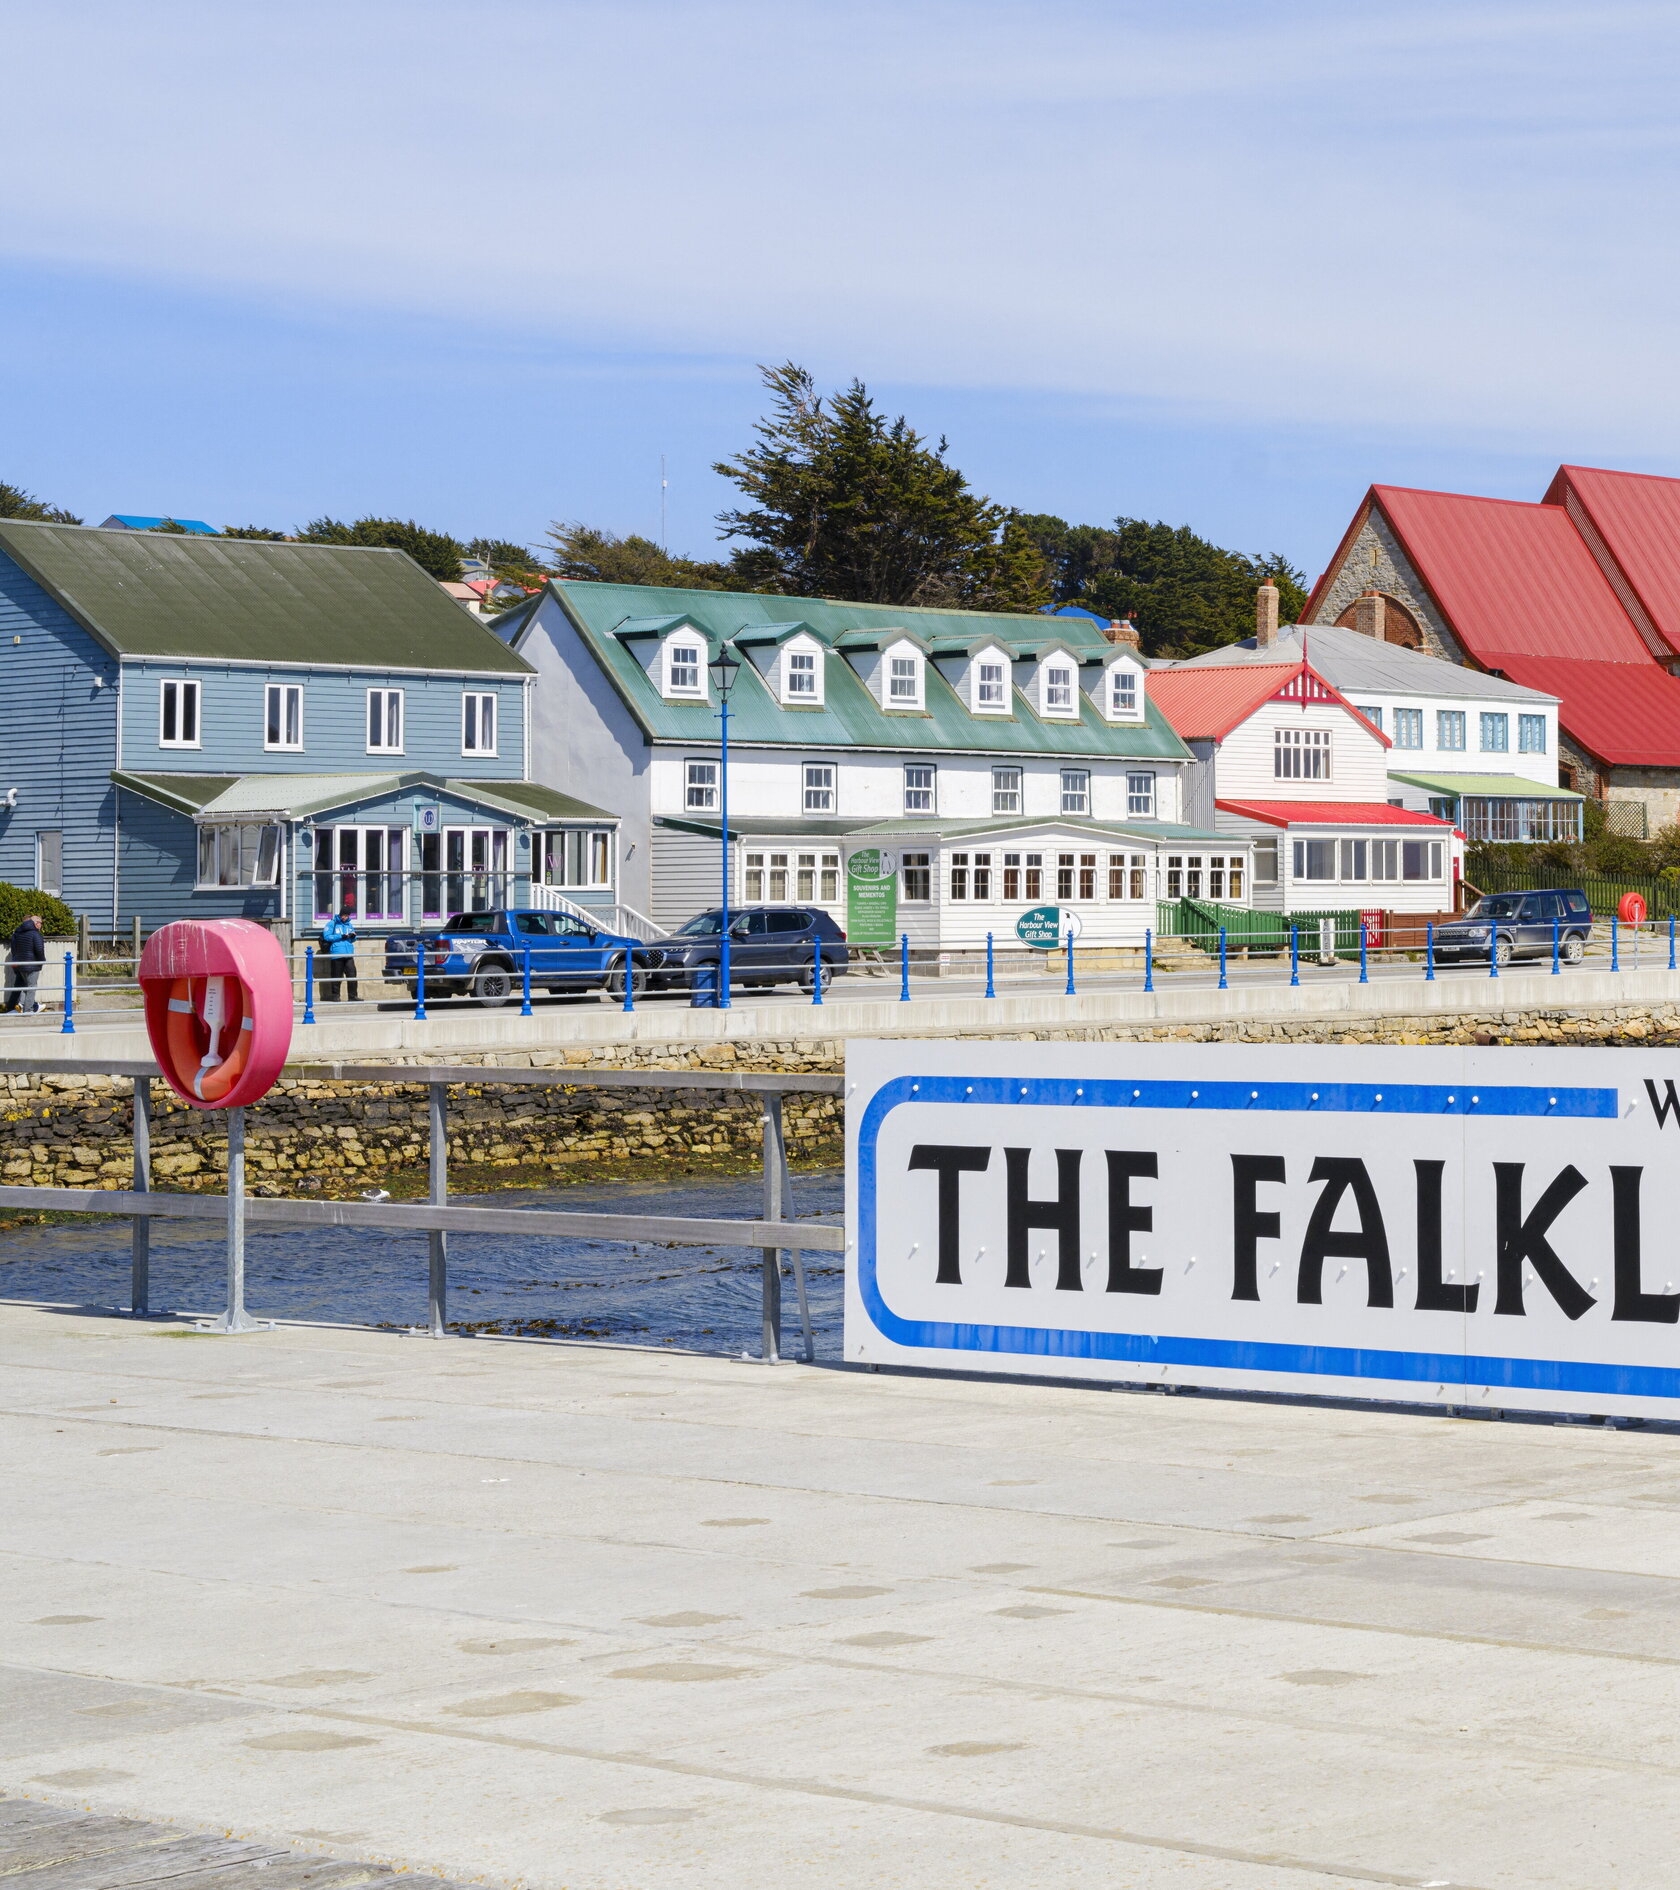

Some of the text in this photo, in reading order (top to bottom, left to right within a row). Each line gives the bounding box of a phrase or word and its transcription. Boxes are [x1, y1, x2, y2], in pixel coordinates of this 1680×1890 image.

[852, 864, 879, 875] Gift Shop
[1038, 930, 1052, 938] Shop
[906, 1144, 1165, 1296] THE
